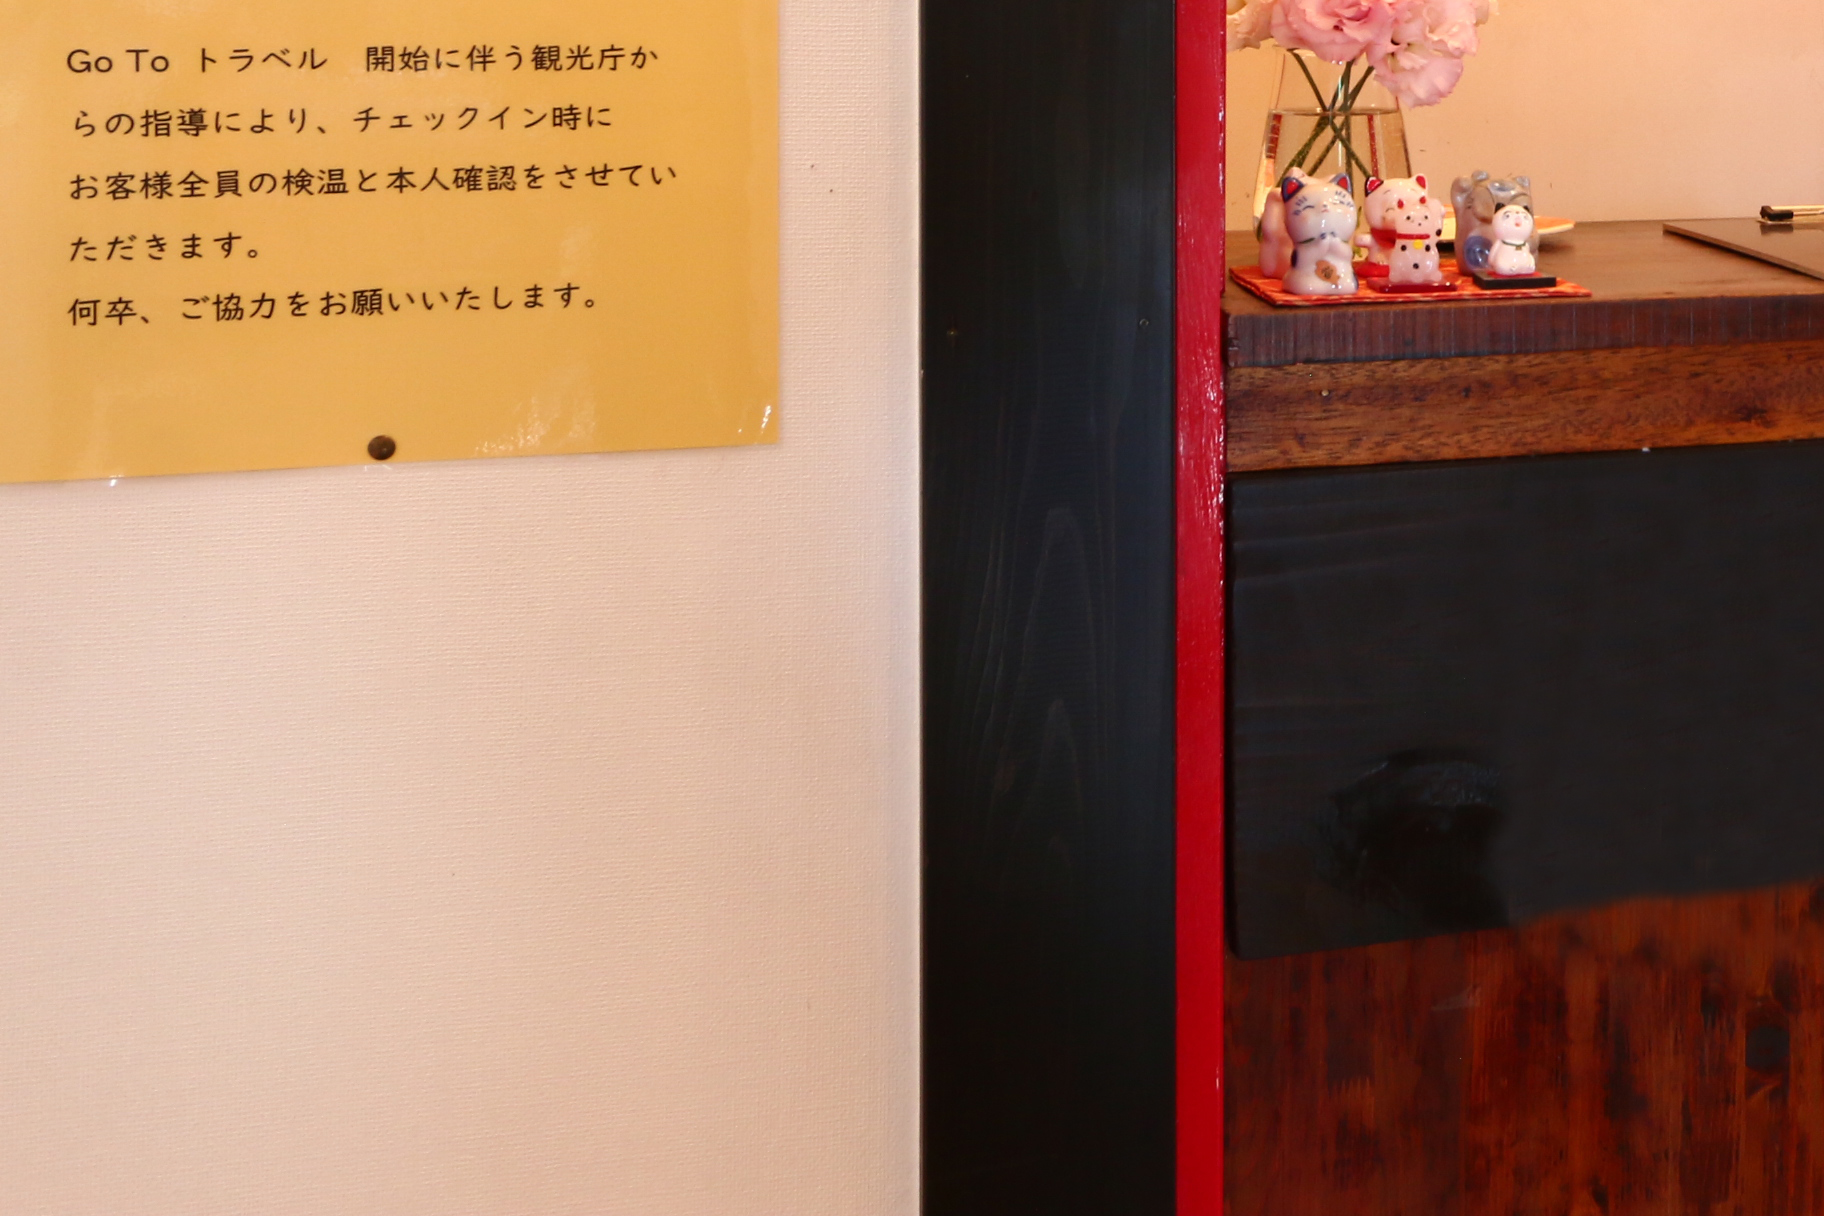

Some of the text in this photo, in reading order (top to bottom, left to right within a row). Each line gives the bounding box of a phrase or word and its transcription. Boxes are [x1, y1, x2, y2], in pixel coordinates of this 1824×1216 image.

[66, 43, 660, 75] Go To トラベル 開始に伴う観光庁か
[73, 103, 613, 138] らの指導により、チェックイン時に
[69, 162, 678, 200] お客様全員の検温と本人確認をさせてい
[69, 232, 261, 263] ただきます。
[68, 282, 597, 327] 何卒、ご協力をお願いいたします。
